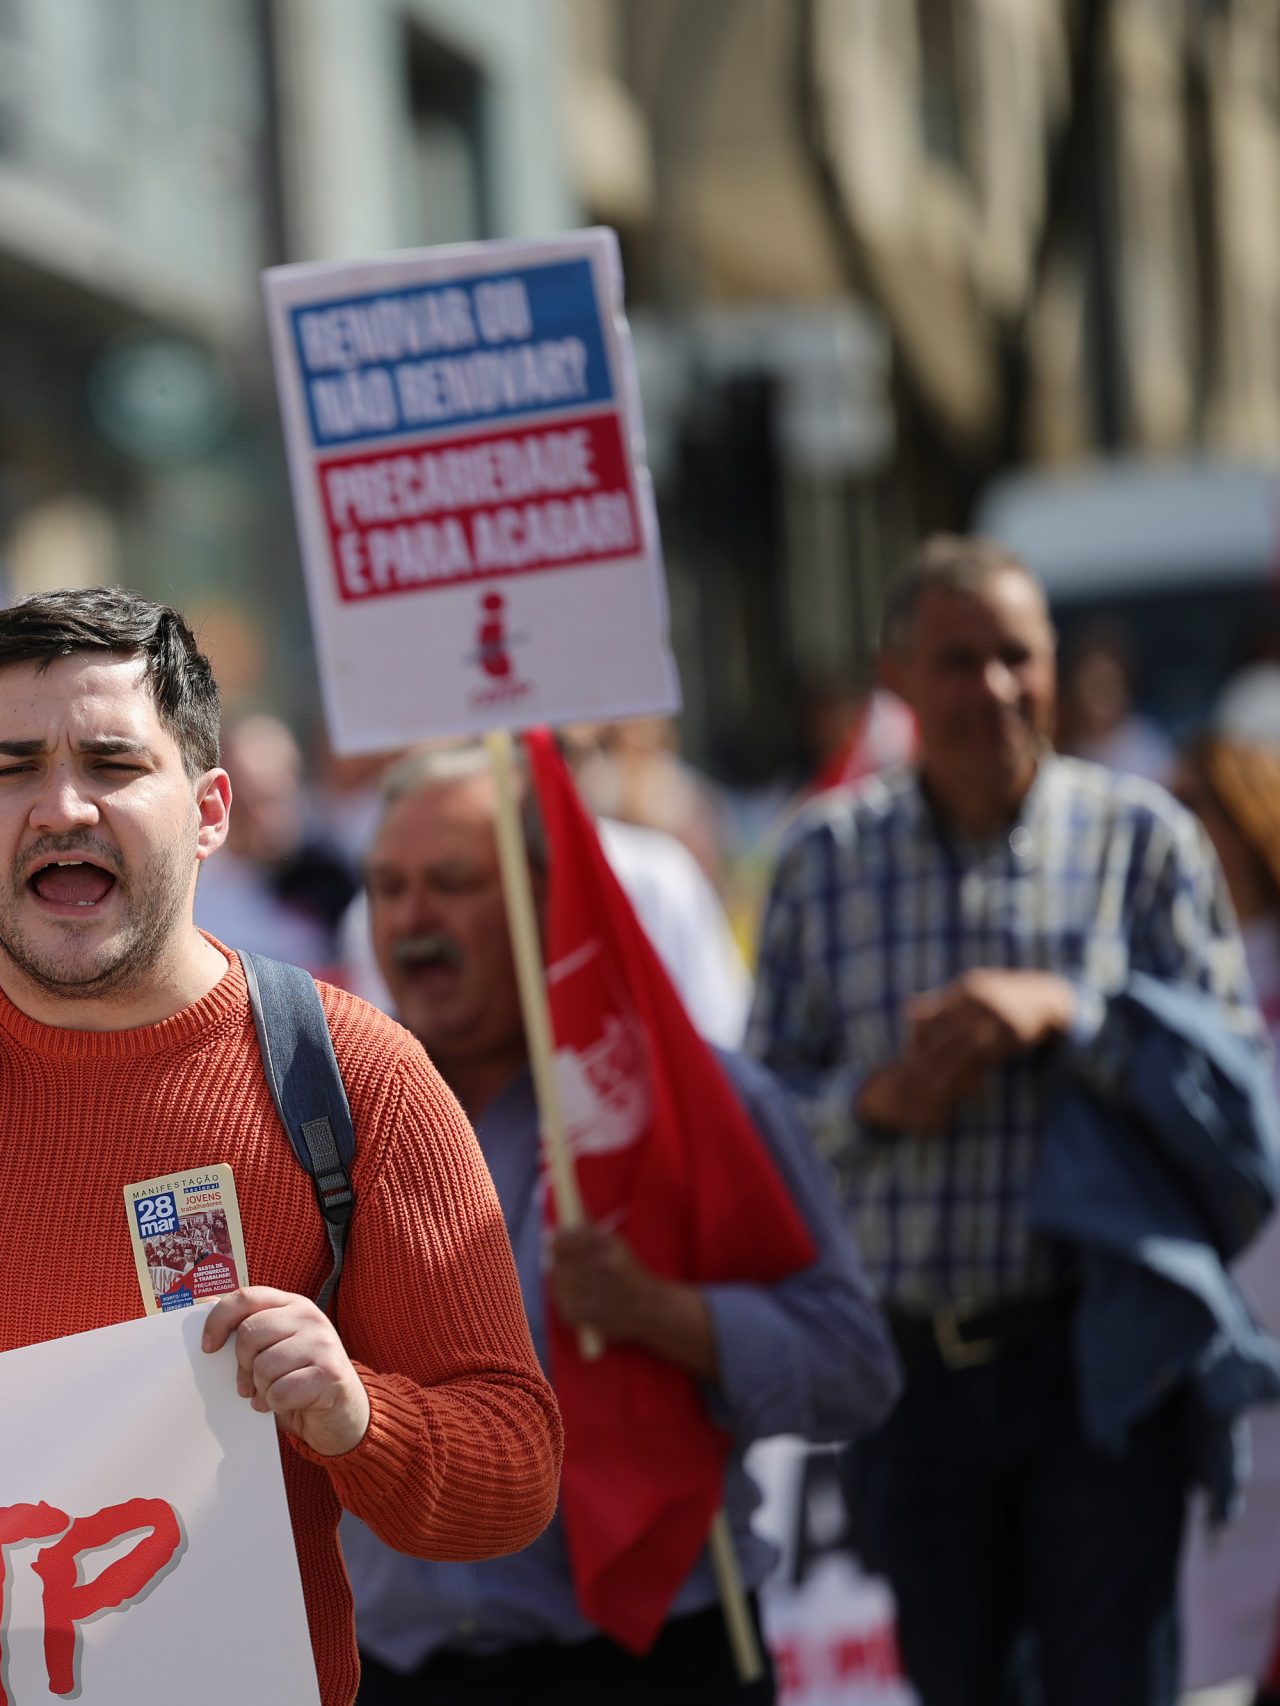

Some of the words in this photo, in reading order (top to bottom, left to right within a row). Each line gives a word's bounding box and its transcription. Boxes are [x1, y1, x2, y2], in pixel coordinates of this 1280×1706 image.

[297, 285, 477, 371] RENOVAR
[474, 278, 532, 343] OU
[309, 364, 399, 438] NÃO
[395, 336, 589, 424] RENOVAR?
[326, 426, 600, 530] PRECARIEDADE
[337, 526, 370, 594] É
[367, 515, 470, 590] PARA
[472, 490, 634, 571] ACABAR!
[132, 1174, 219, 1199] MANIFESTAÇÃO
[184, 1183, 219, 1193] nacional
[185, 1191, 222, 1205] JOVENS
[137, 1195, 174, 1223] 28
[180, 1200, 223, 1213] trabalhadores
[140, 1216, 176, 1237] mar
